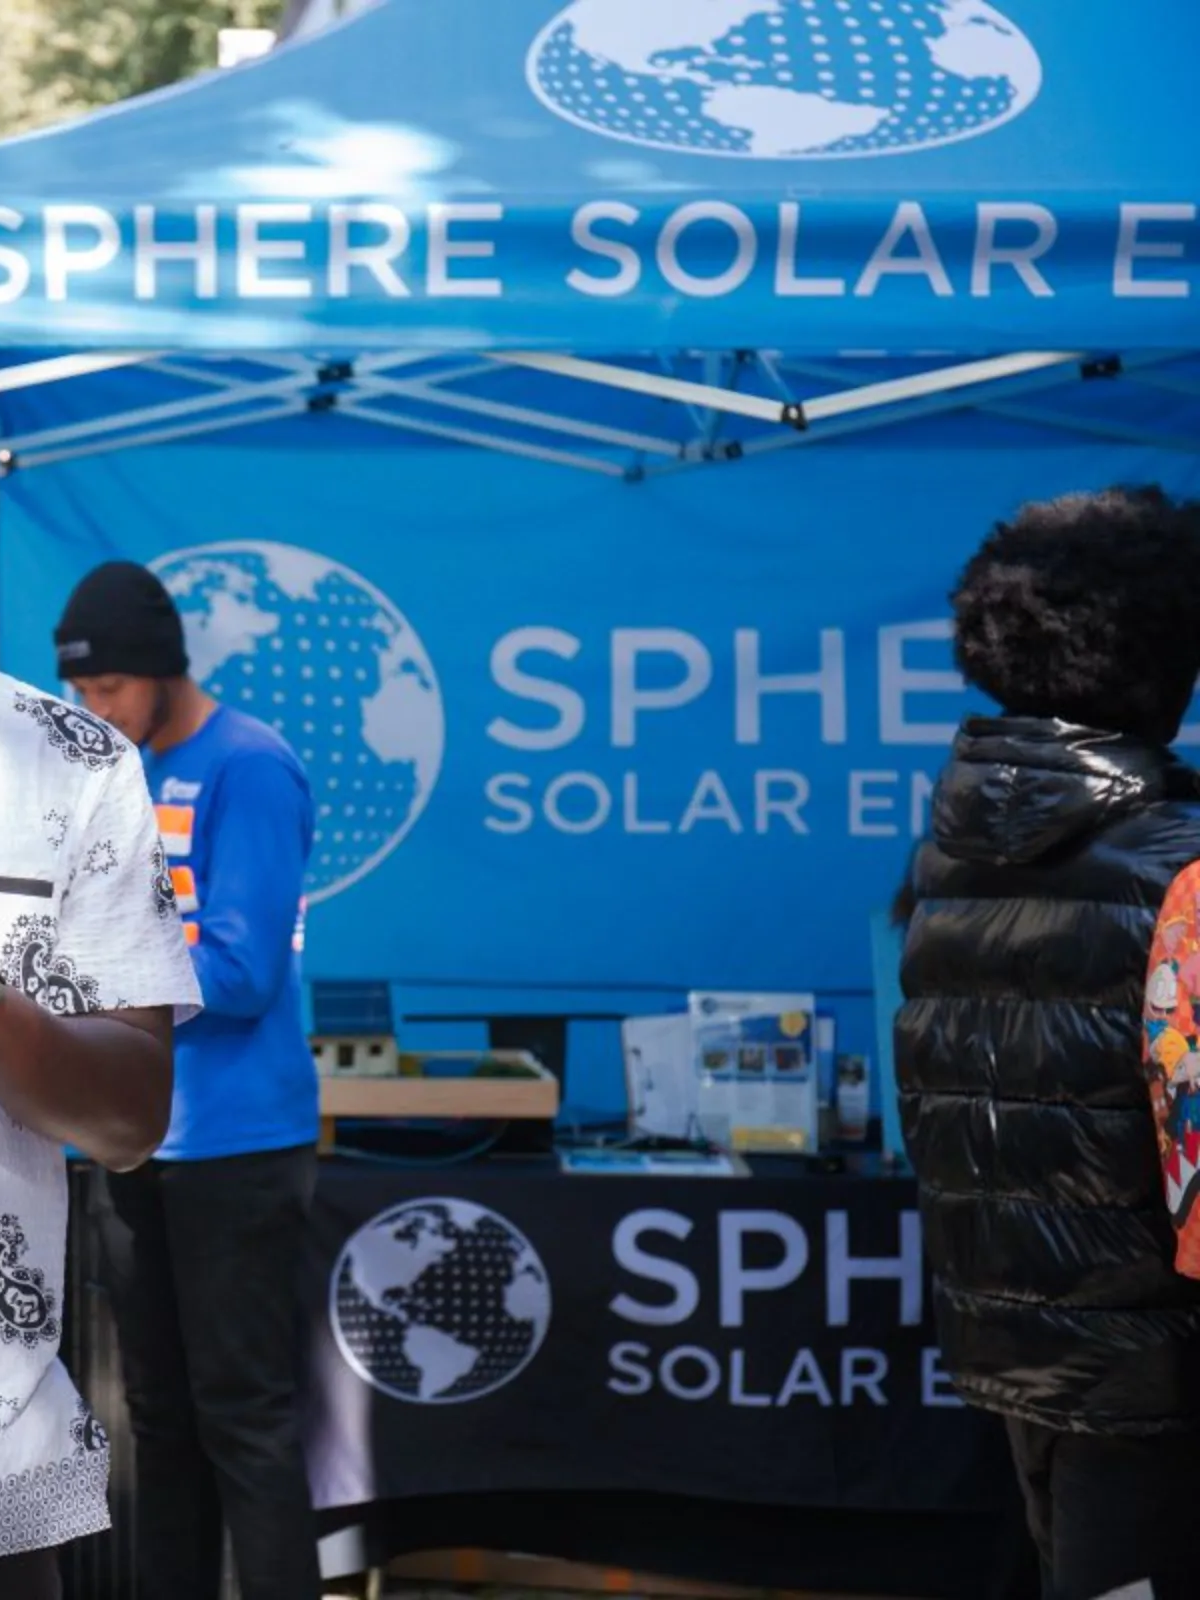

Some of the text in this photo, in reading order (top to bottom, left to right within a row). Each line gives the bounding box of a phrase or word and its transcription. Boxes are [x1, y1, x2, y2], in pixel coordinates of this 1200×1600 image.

[565, 200, 1058, 297] SOLAR
[1112, 202, 1197, 297] E
[486, 618, 968, 751] SPHE
[483, 768, 811, 835] SOLAR
[608, 1207, 924, 1328] SPH
[606, 1340, 968, 1407] SOLAR E
